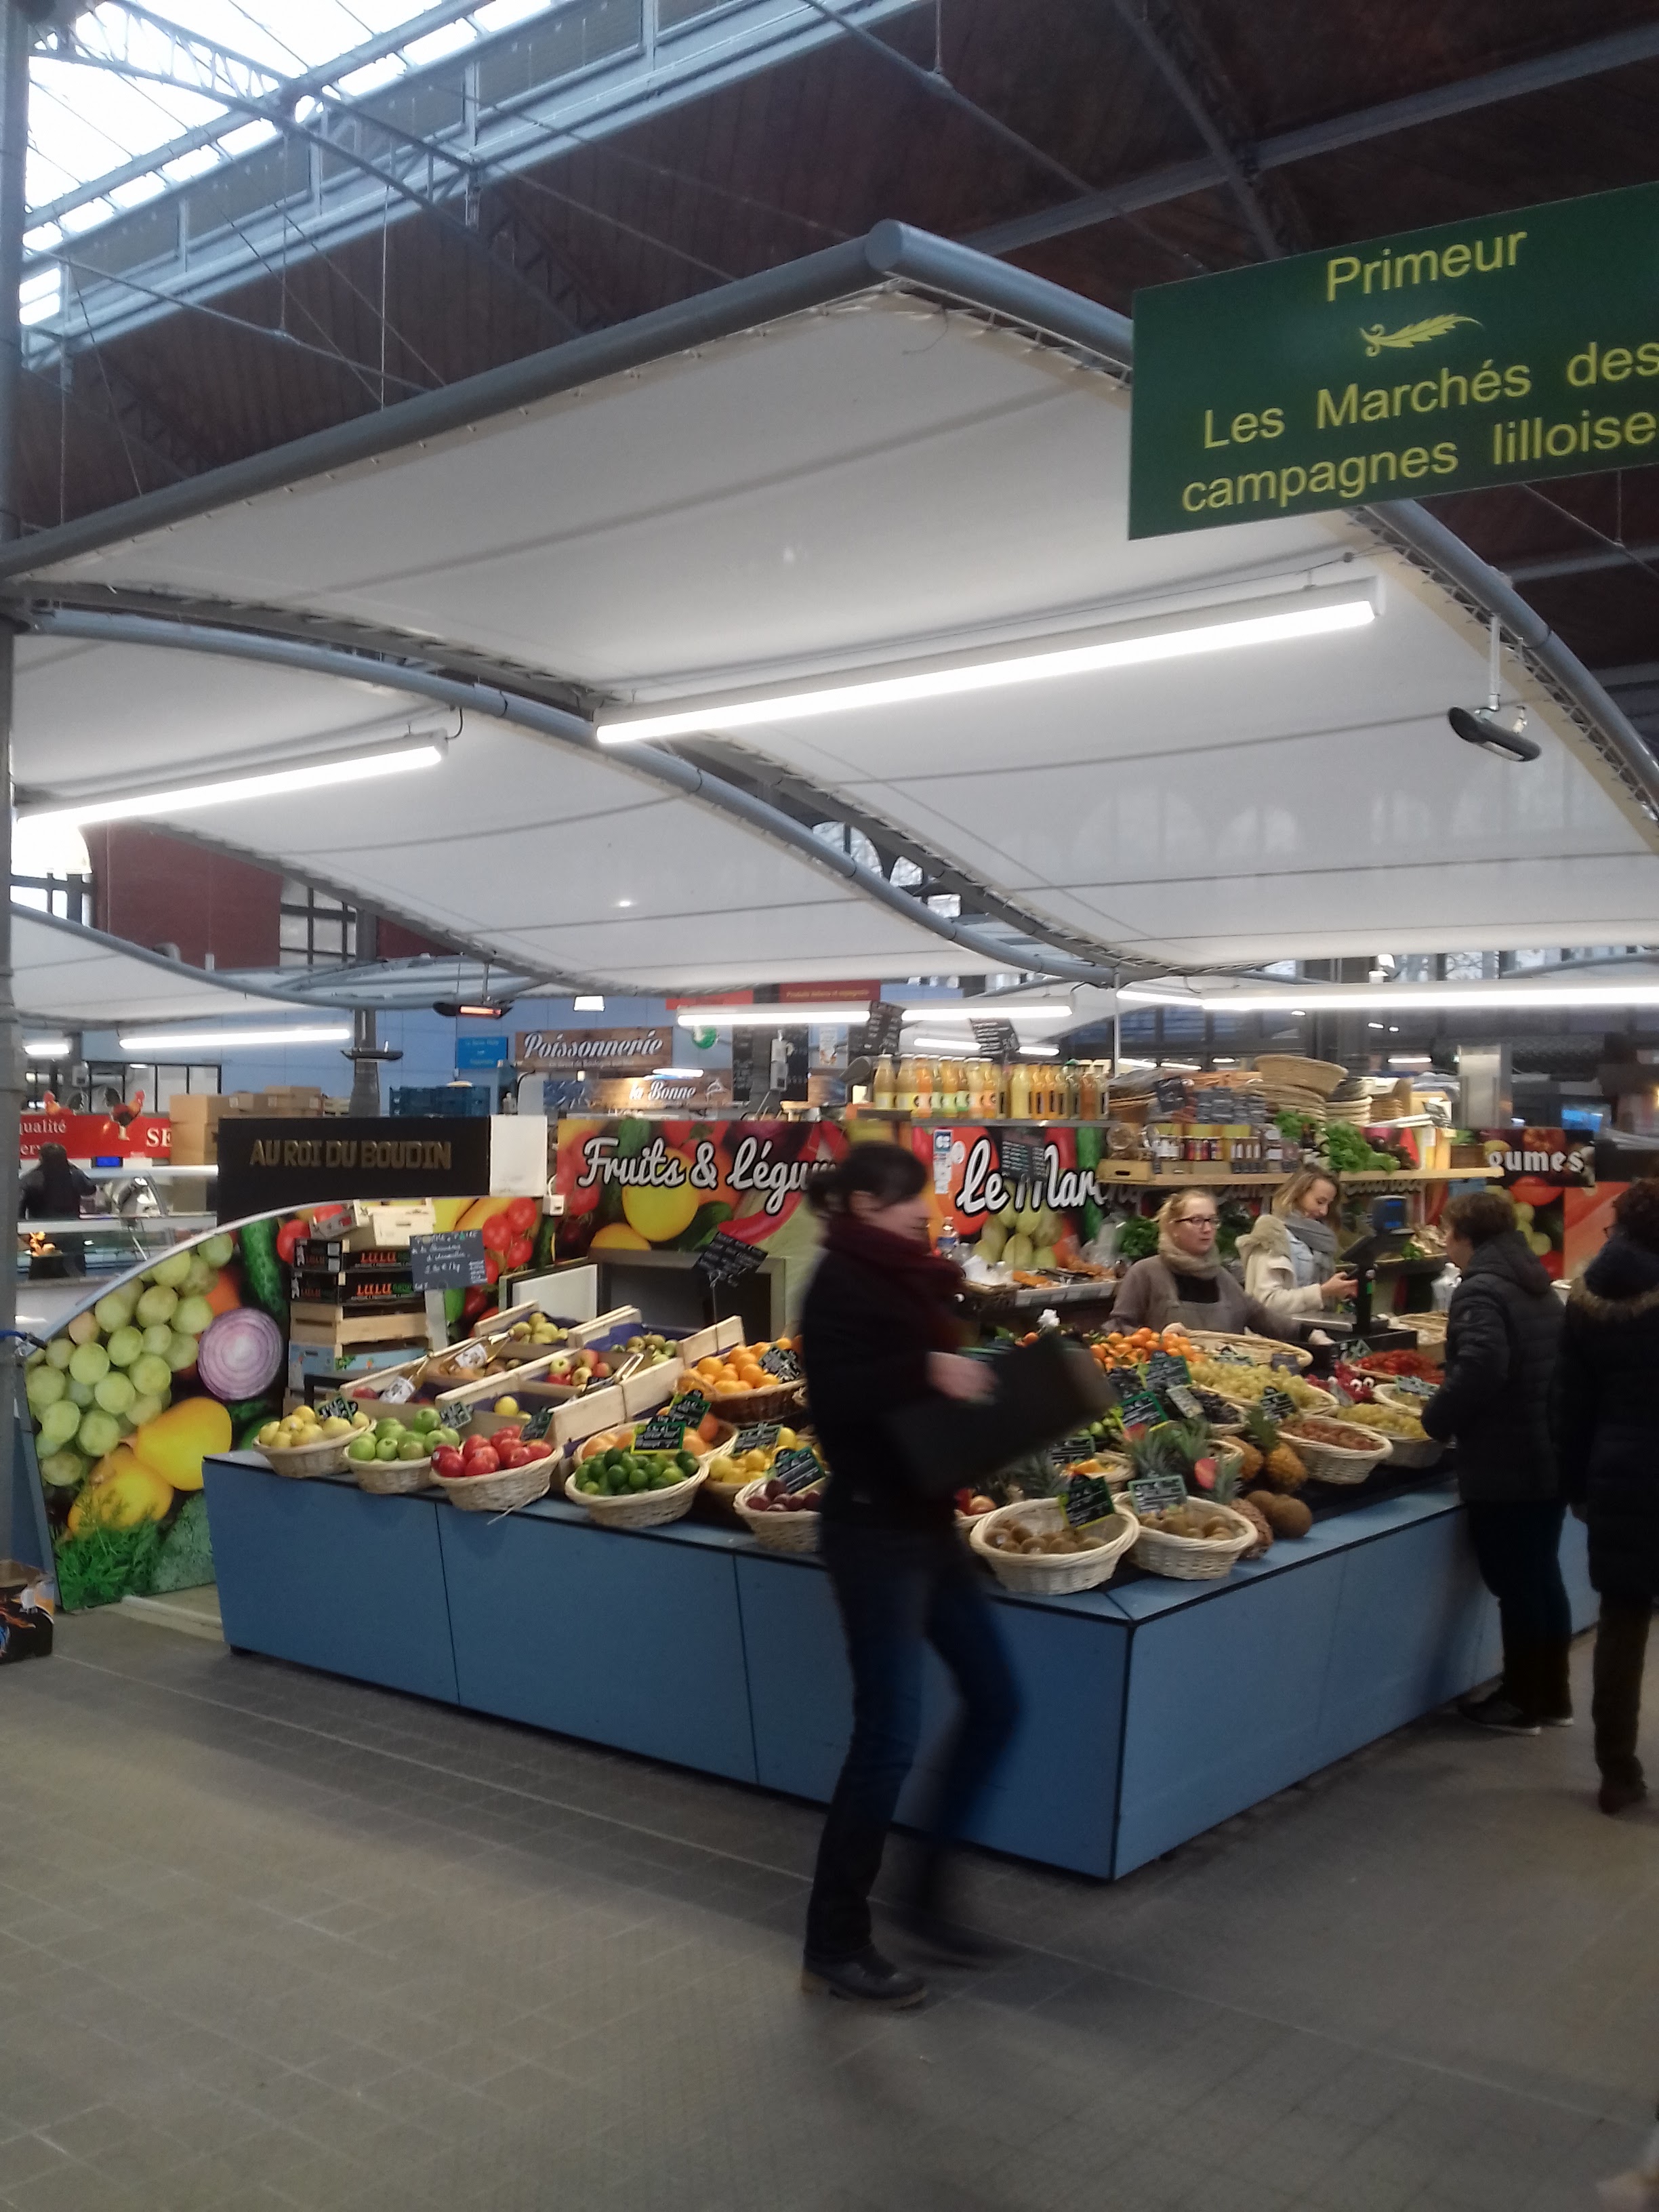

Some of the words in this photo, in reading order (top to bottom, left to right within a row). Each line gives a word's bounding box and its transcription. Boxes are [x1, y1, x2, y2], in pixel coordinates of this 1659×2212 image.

[1326, 231, 1528, 302] Primeur
[1204, 407, 1285, 449] Les
[1316, 359, 1531, 430] Marchés
[1567, 341, 1659, 387] des
[1181, 441, 1458, 513] campagnes
[1493, 409, 1657, 466] lilloise
[523, 1029, 664, 1059] Poissonnerie
[648, 1080, 696, 1101] Bonne
[249, 1139, 280, 1166] AU
[284, 1140, 322, 1167] ROI
[325, 1140, 357, 1168] DU
[361, 1140, 452, 1170] BOUDIN
[578, 1136, 685, 1187] Fruits
[690, 1141, 718, 1190] &
[726, 1136, 836, 1215] Légu
[1015, 1144, 1107, 1210] Mar
[361, 1251, 397, 1264] LULU
[356, 1282, 392, 1296] LULU
